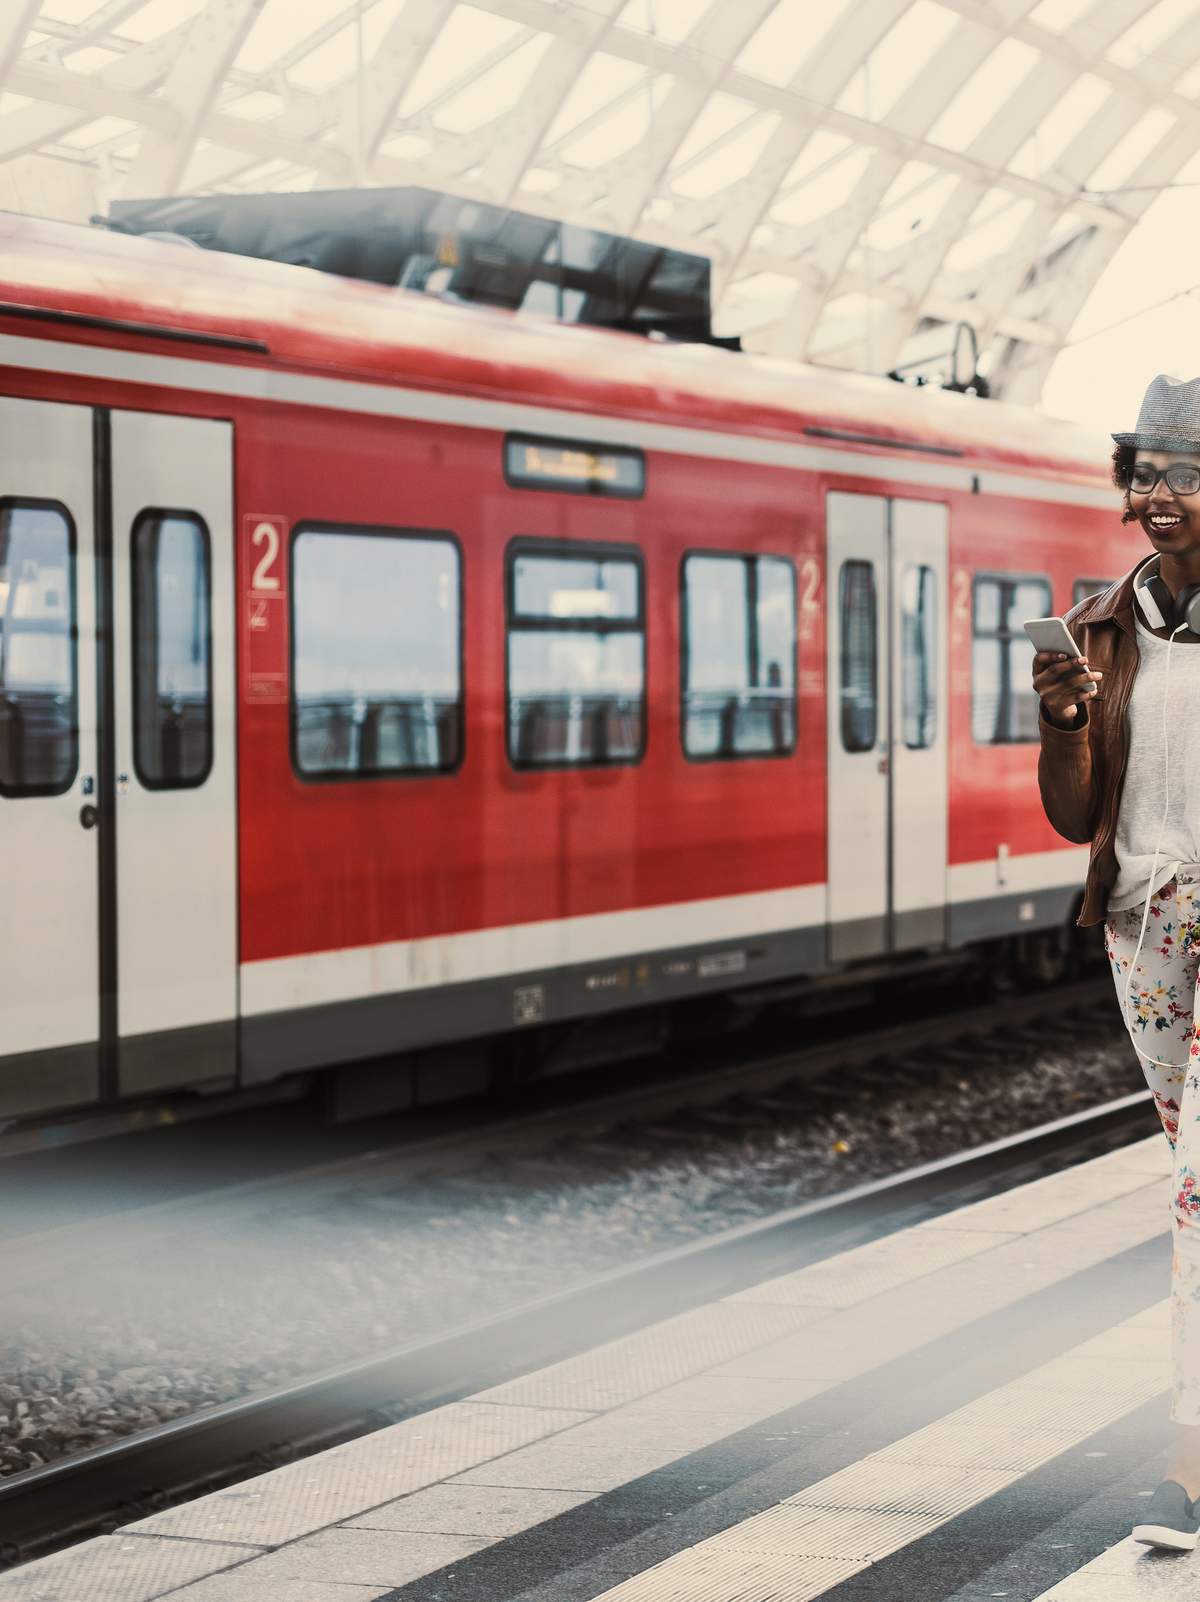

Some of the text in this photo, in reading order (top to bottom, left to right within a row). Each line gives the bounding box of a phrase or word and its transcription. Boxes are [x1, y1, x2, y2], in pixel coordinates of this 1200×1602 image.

[252, 522, 280, 590] 2
[801, 559, 821, 610] 2
[953, 570, 970, 619] 2
